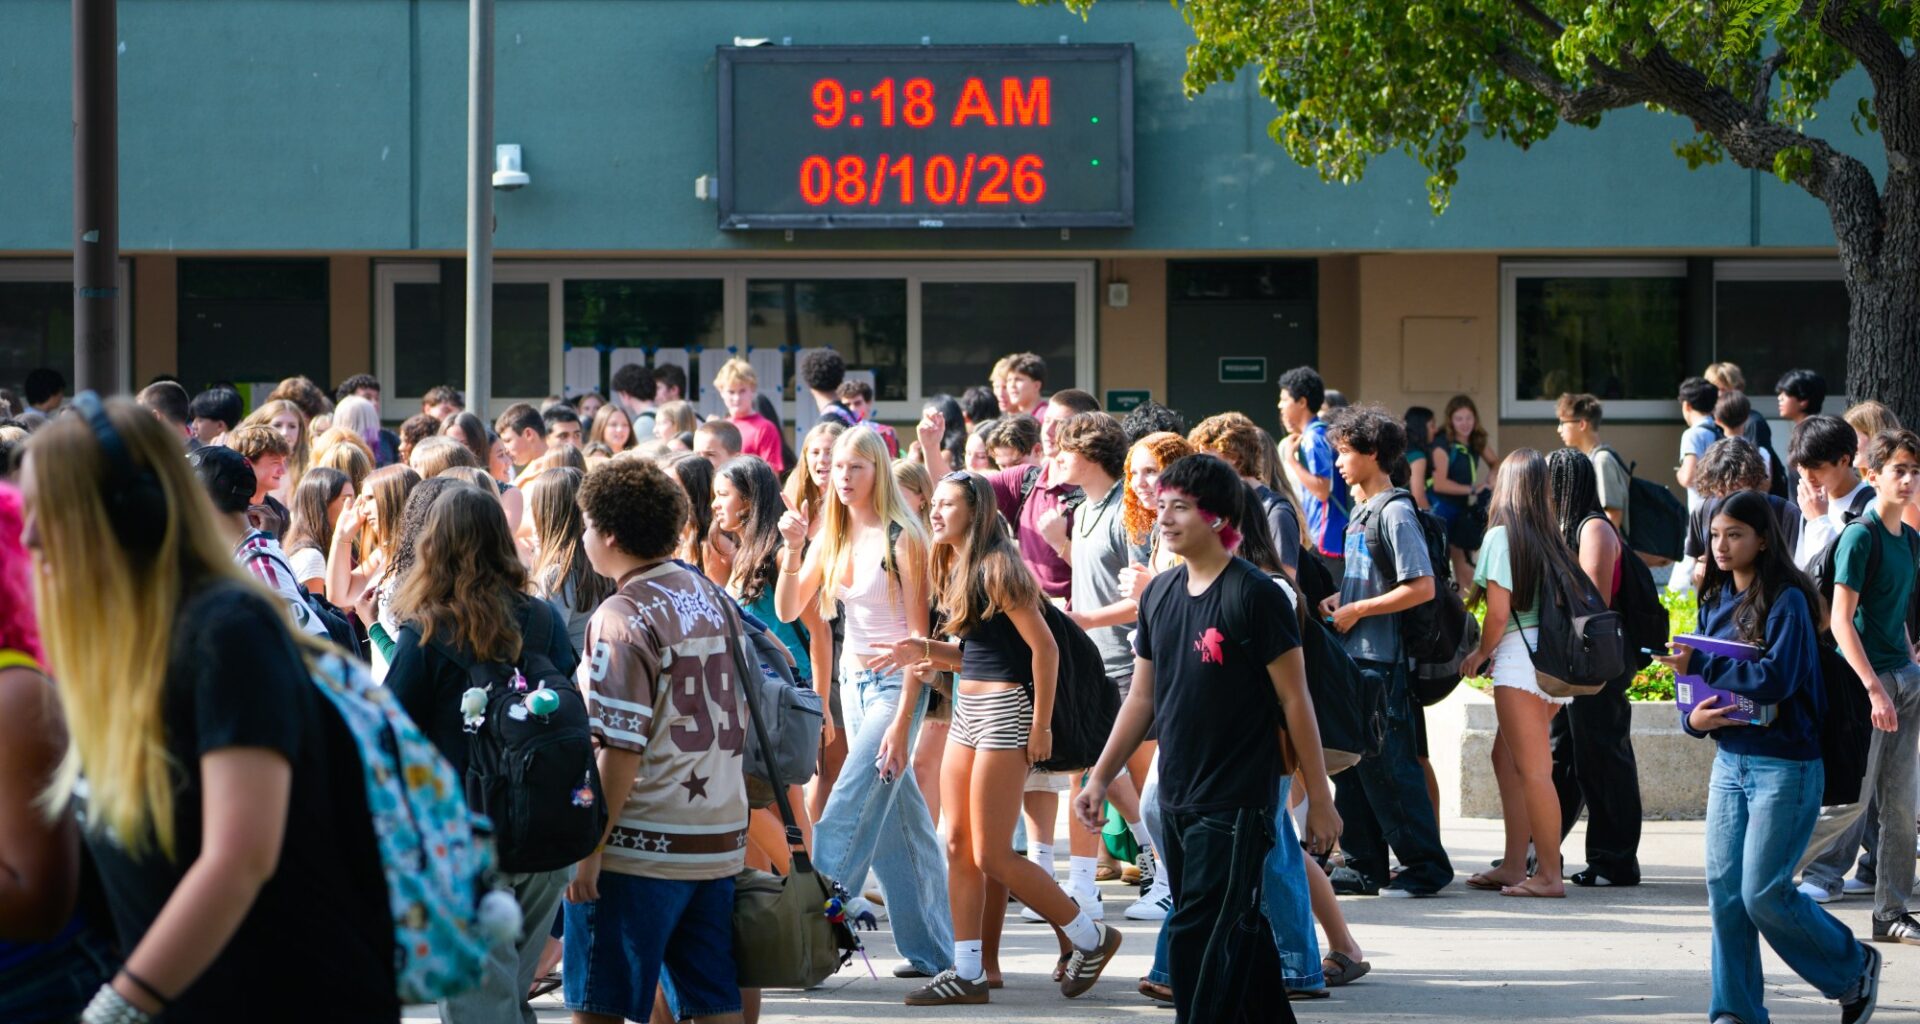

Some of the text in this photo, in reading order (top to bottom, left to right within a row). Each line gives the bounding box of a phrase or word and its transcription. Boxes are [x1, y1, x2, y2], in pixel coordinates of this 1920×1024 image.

[811, 76, 1051, 128] 9:18 AM
[800, 153, 1046, 205] 08/10/26
[669, 652, 744, 753] 99
